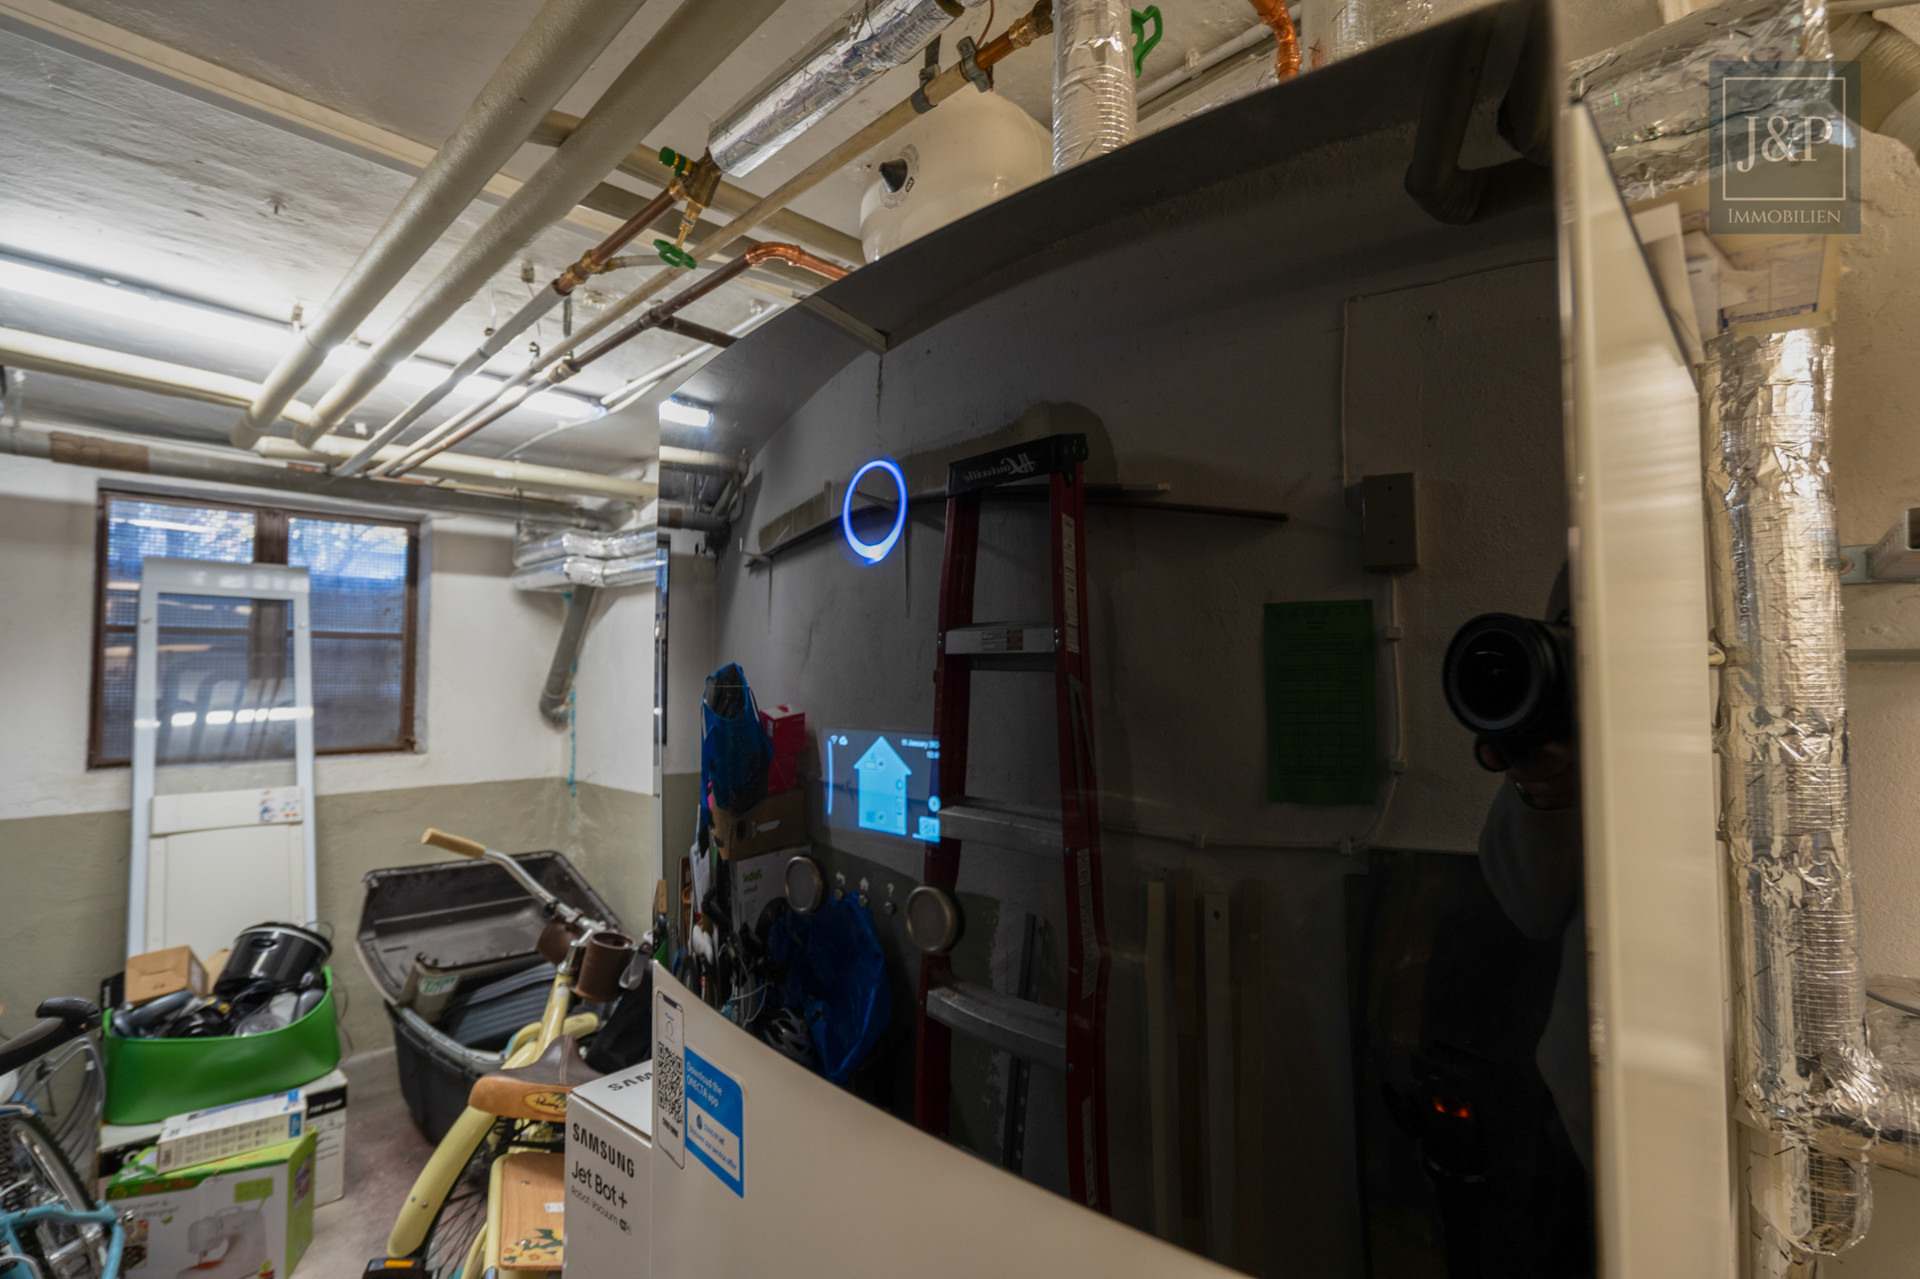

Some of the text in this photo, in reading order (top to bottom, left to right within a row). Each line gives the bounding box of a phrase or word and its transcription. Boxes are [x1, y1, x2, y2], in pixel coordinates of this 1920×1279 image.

[1736, 552, 1750, 621] ROCKWOOL
[687, 1061, 722, 1096] Download the
[708, 1093, 719, 1108] app
[573, 1123, 634, 1178] SAMSUNG
[572, 1160, 592, 1189] Jet
[571, 1185, 619, 1226] Robot Vacuum
